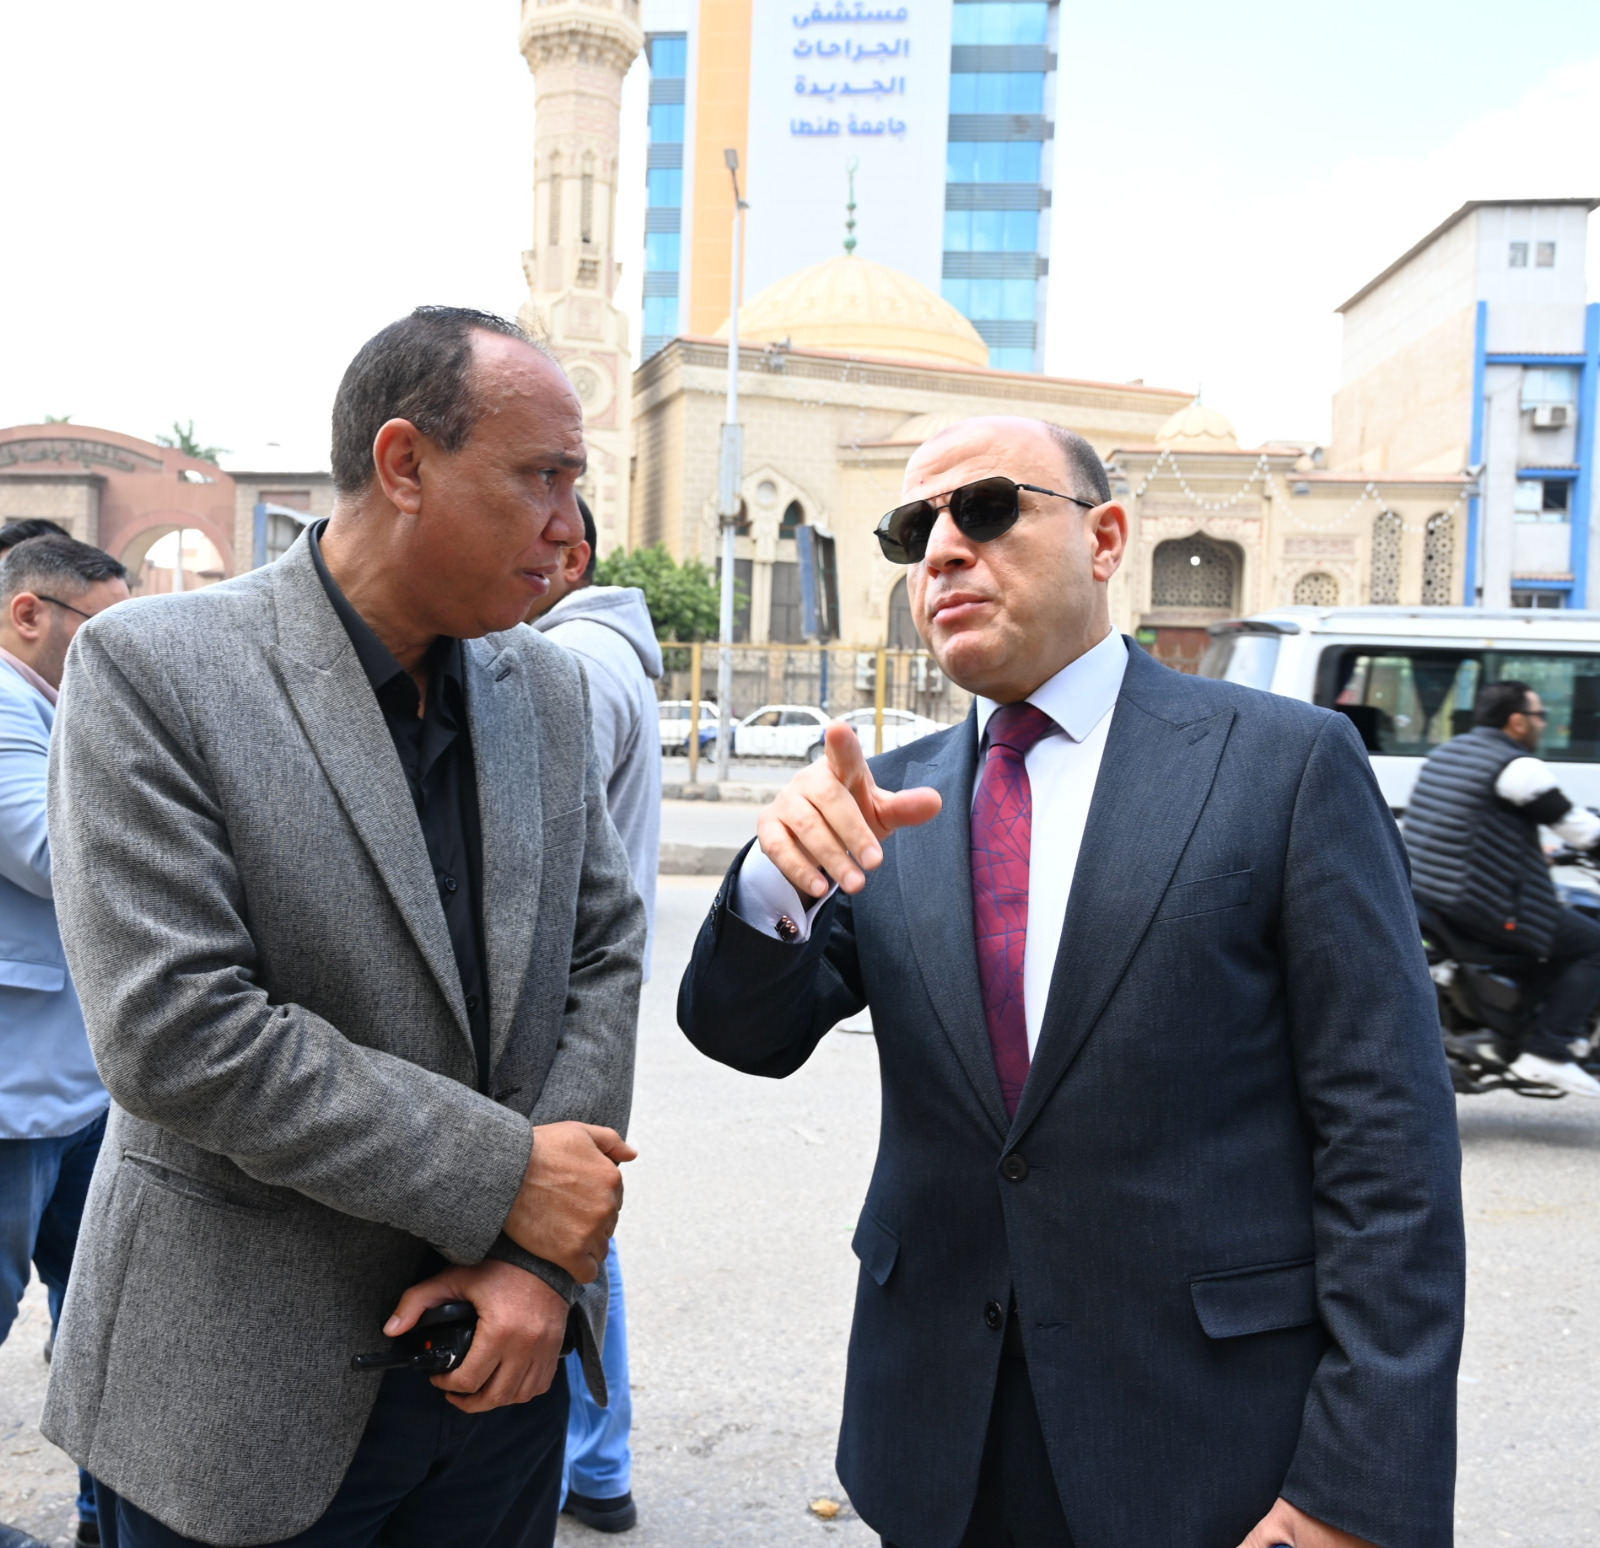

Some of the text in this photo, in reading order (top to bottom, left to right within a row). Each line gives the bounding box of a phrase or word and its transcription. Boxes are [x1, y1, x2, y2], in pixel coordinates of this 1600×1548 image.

[792, 0, 908, 29] مستشفى
[792, 38, 911, 63] الجراحات
[794, 74, 906, 103] الجديدة
[789, 113, 908, 141] جامعة طنطا
